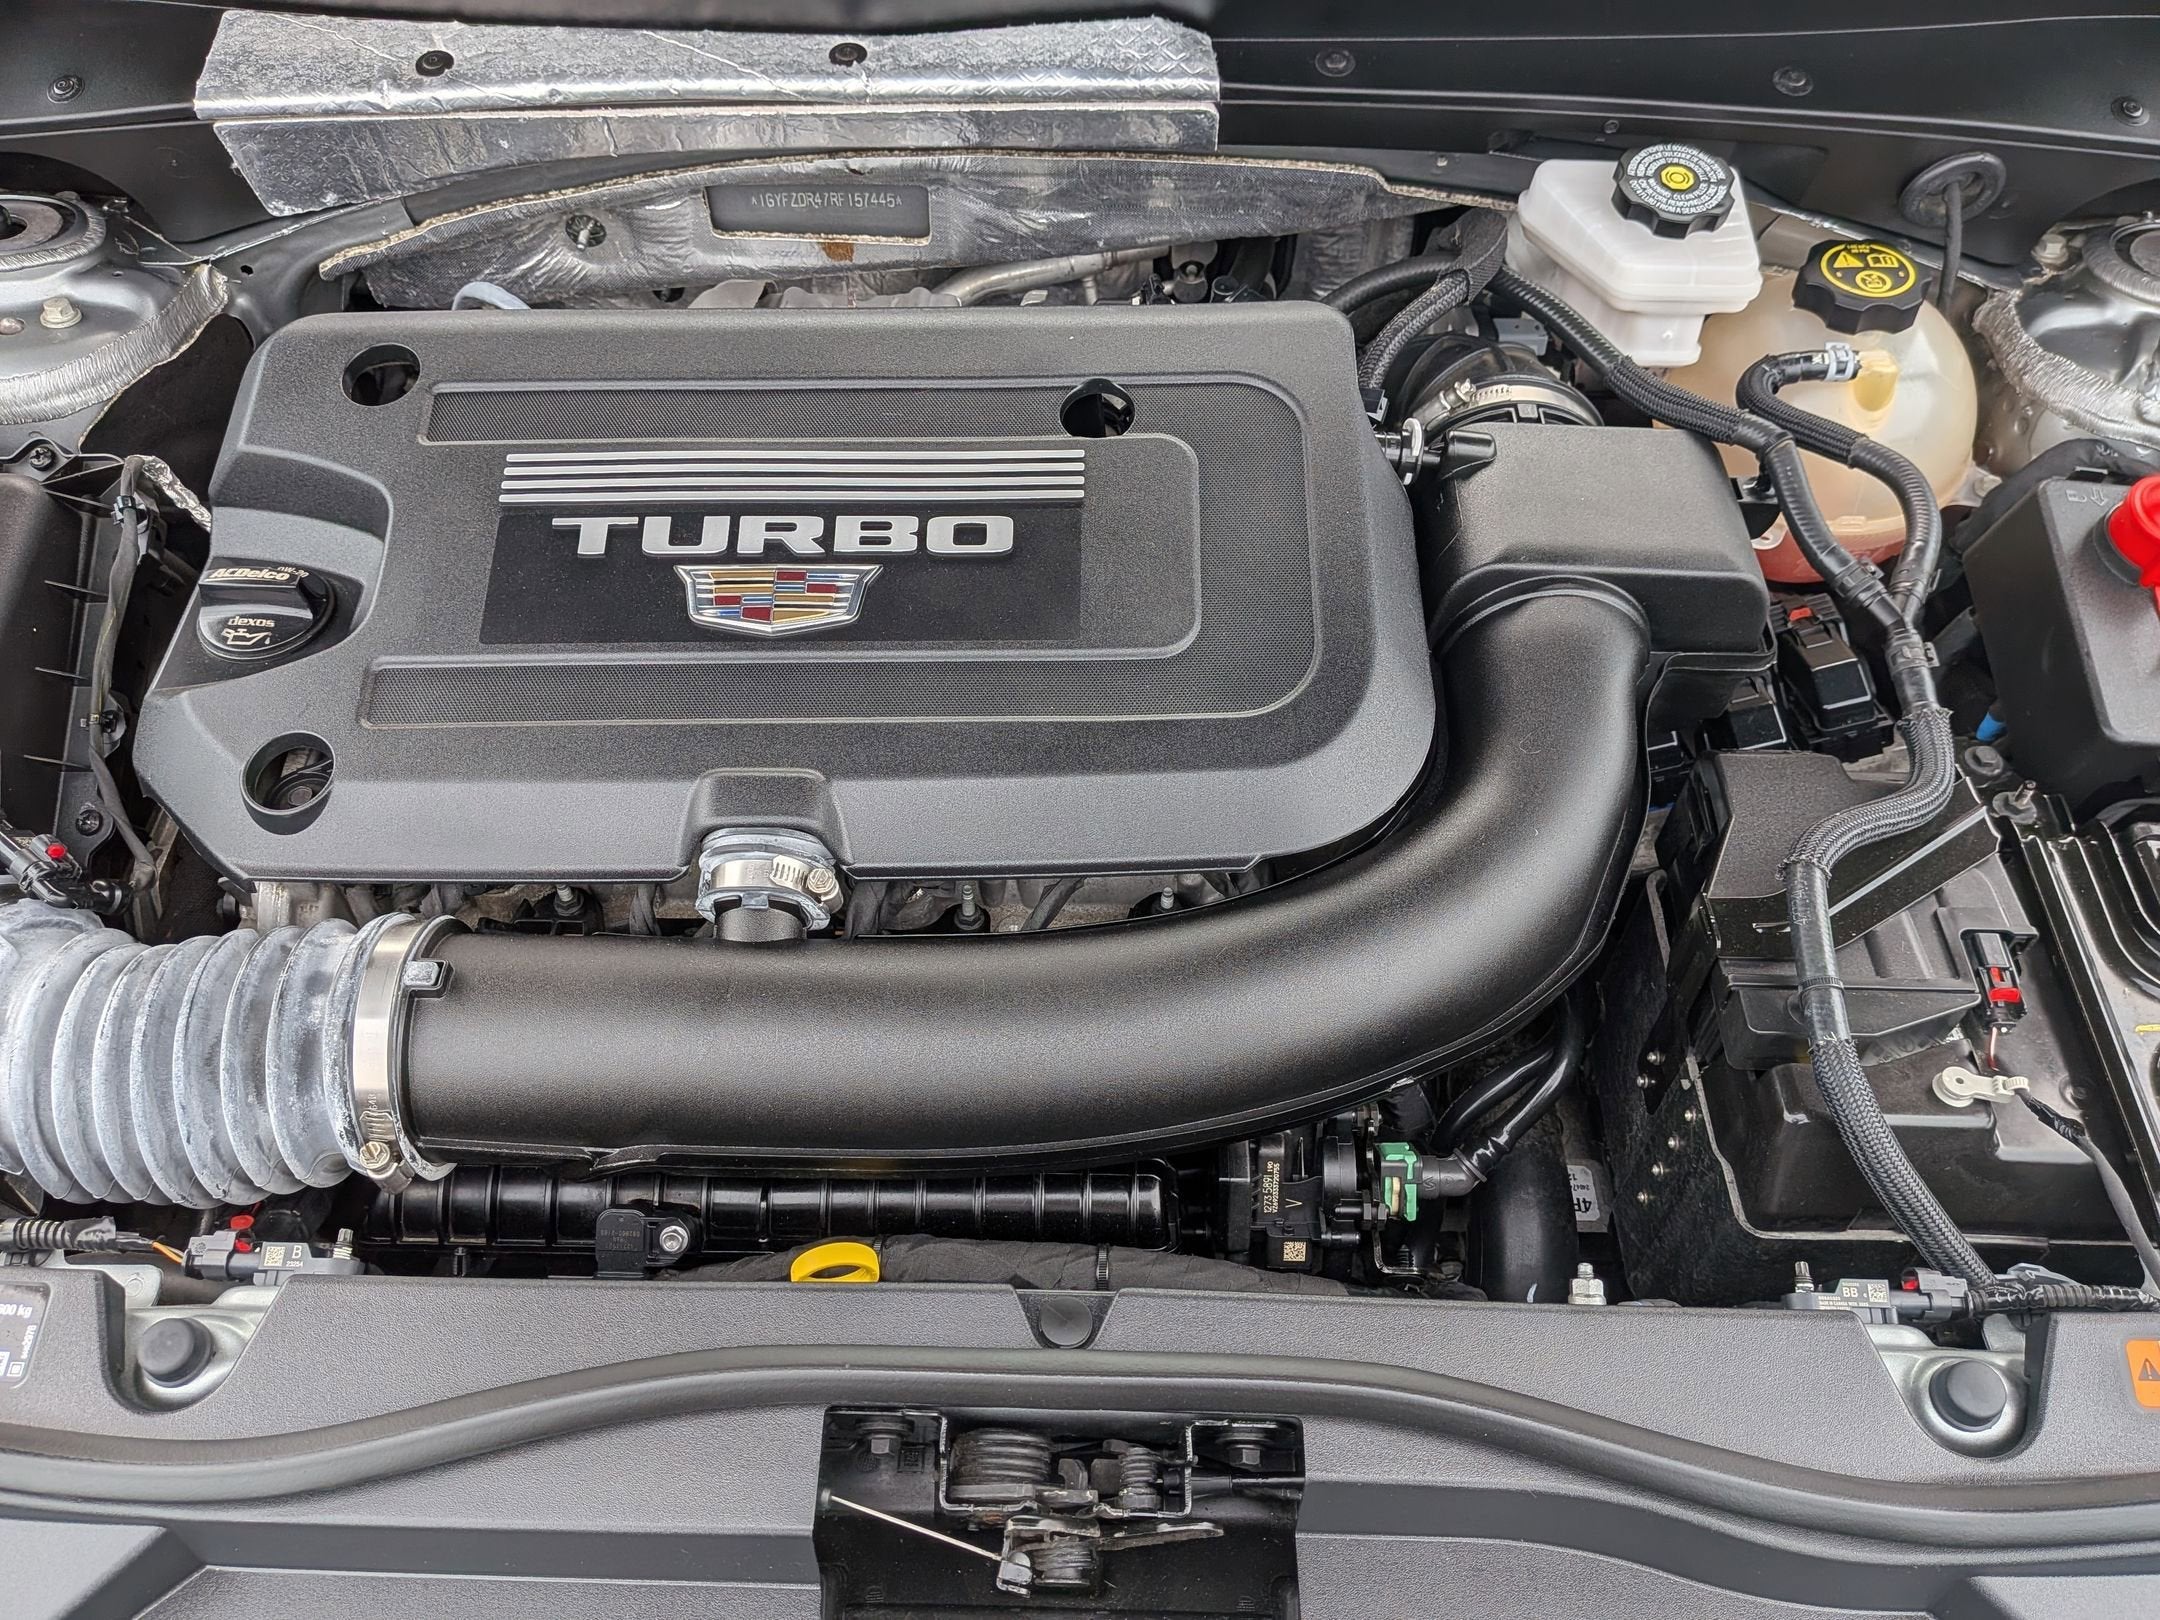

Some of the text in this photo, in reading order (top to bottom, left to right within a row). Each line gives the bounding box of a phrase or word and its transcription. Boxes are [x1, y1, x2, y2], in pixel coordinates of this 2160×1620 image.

[551, 515, 1015, 557] TURBO
[227, 615, 276, 628] dexos
[1263, 1195, 1273, 1213] 1273
[1284, 1198, 1303, 1209] V
[291, 1245, 302, 1259] B
[1842, 1286, 1859, 1298] BB
[17, 1303, 33, 1319] kg
